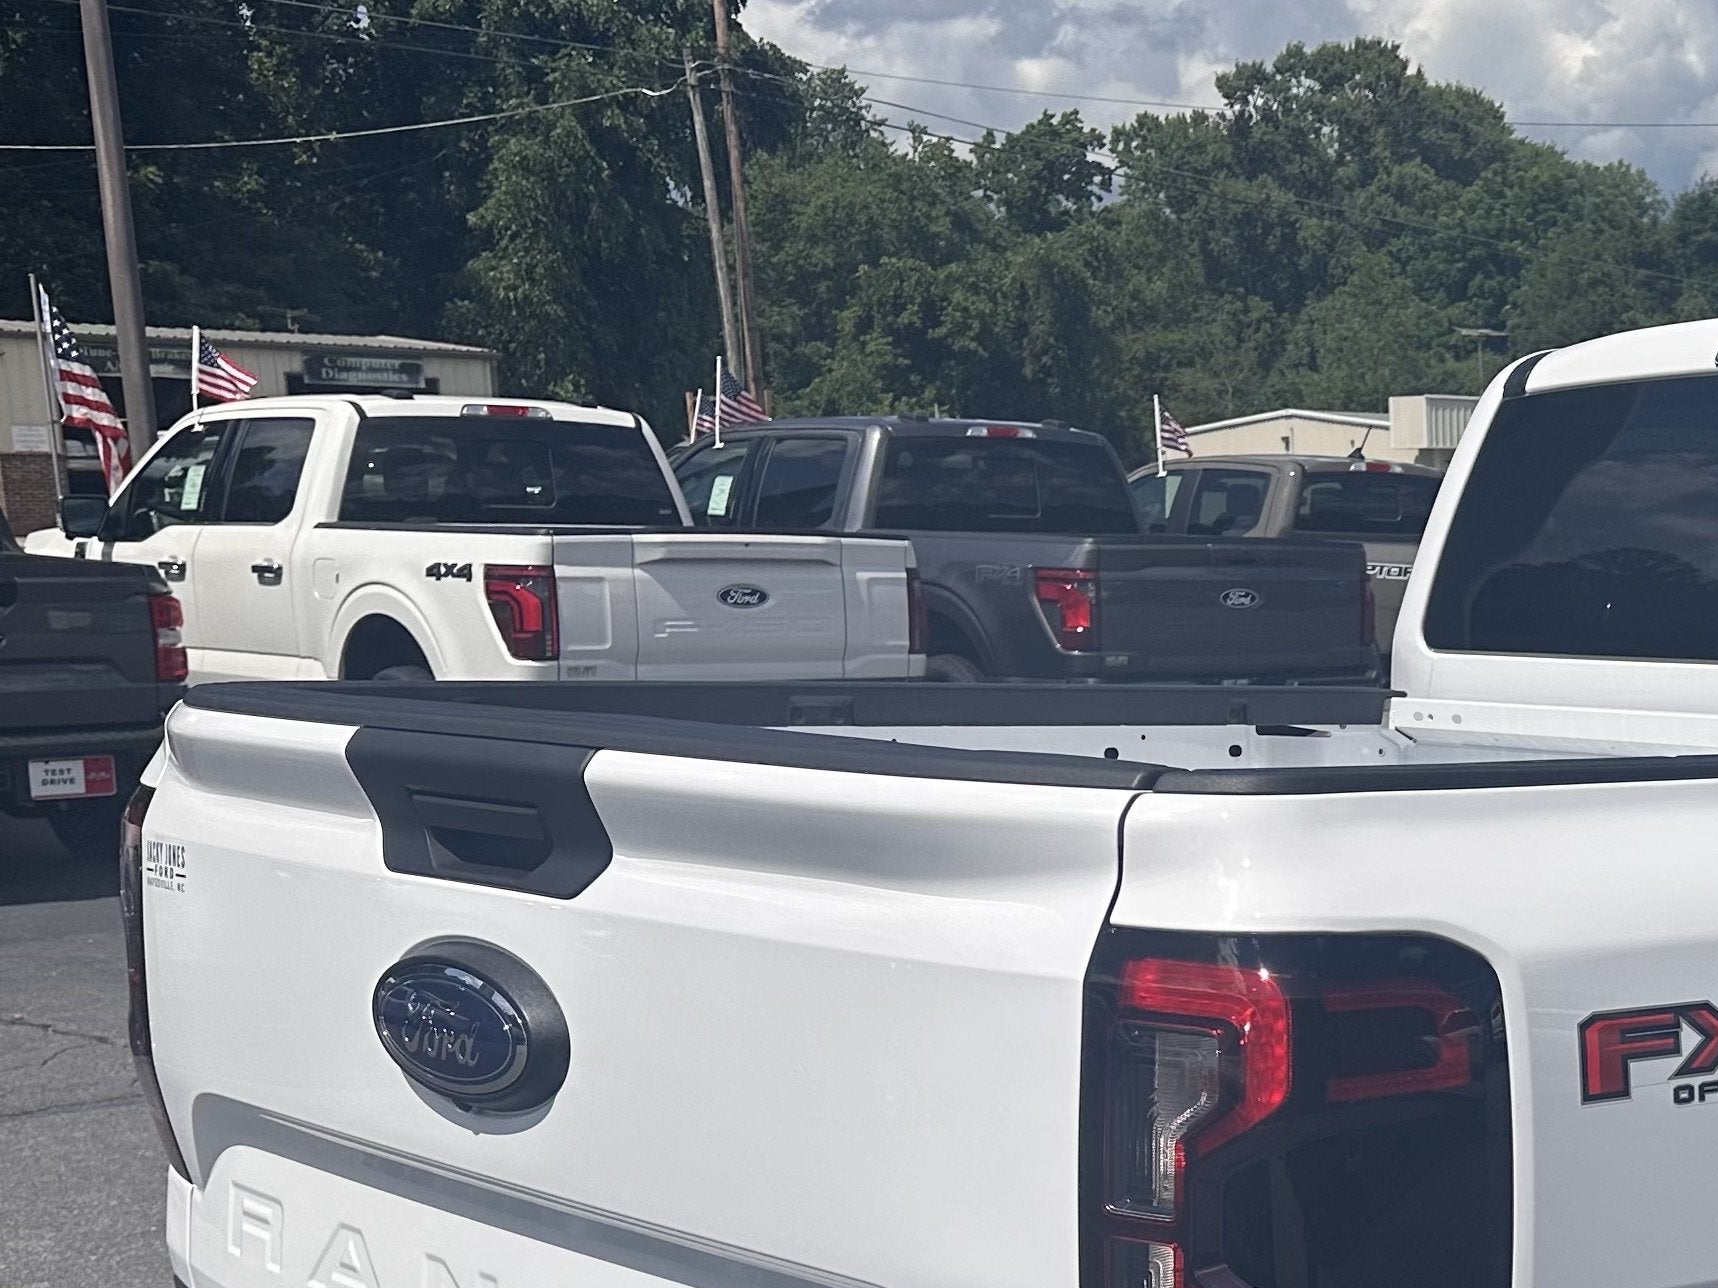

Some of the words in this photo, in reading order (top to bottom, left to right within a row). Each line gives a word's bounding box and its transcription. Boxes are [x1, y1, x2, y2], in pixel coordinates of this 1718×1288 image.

[323, 357, 399, 370] Computer
[320, 367, 409, 381] Diagnostics
[727, 588, 760, 604] Ford
[43, 768, 72, 777] TEST
[41, 777, 75, 787] DRIVE
[147, 840, 163, 864] JACKY
[165, 843, 186, 869] JONES
[154, 864, 174, 880] FORD
[402, 990, 480, 1068] Ford
